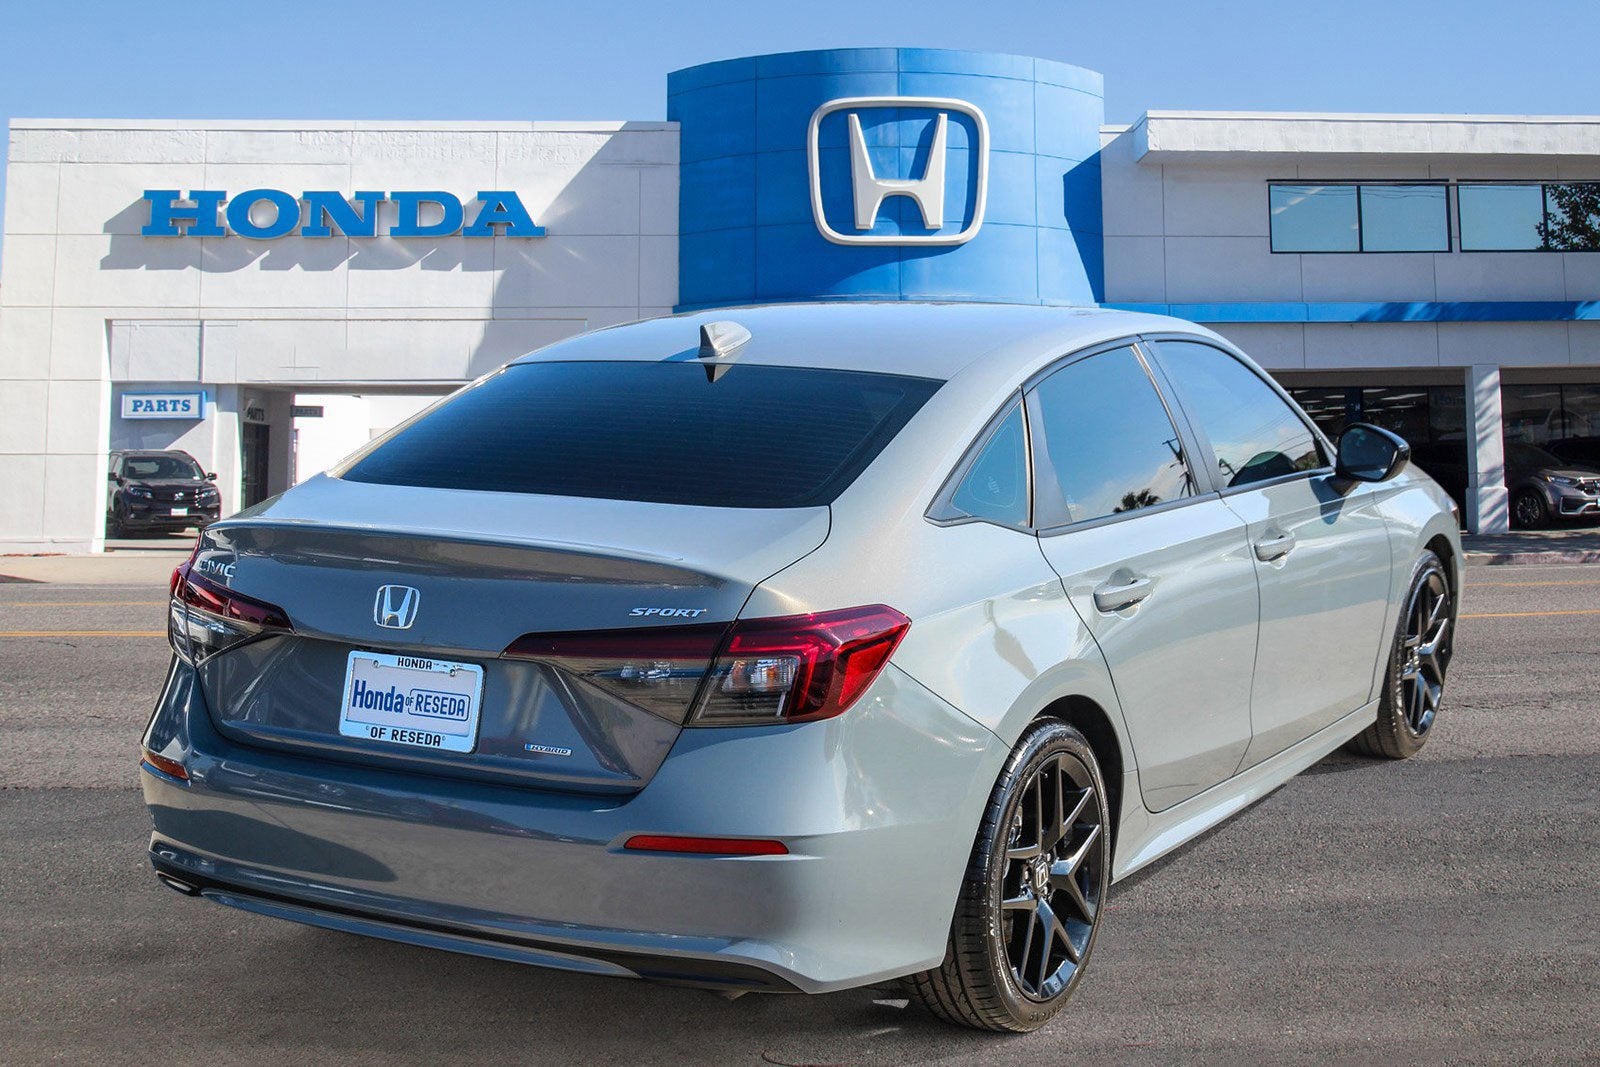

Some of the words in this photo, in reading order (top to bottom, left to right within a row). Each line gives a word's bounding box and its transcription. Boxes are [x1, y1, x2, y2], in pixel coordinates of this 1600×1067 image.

[142, 189, 547, 239] HONDA
[132, 399, 191, 413] PARTS
[198, 559, 236, 578] CIVIC
[629, 608, 707, 617] SPORT
[397, 657, 433, 670] HONDA
[352, 680, 405, 713] Honda
[405, 696, 414, 706] OF
[415, 694, 465, 717] RESEDA
[370, 726, 387, 739] OF
[391, 729, 441, 747] RESEDA
[531, 745, 568, 754] HYBRID
